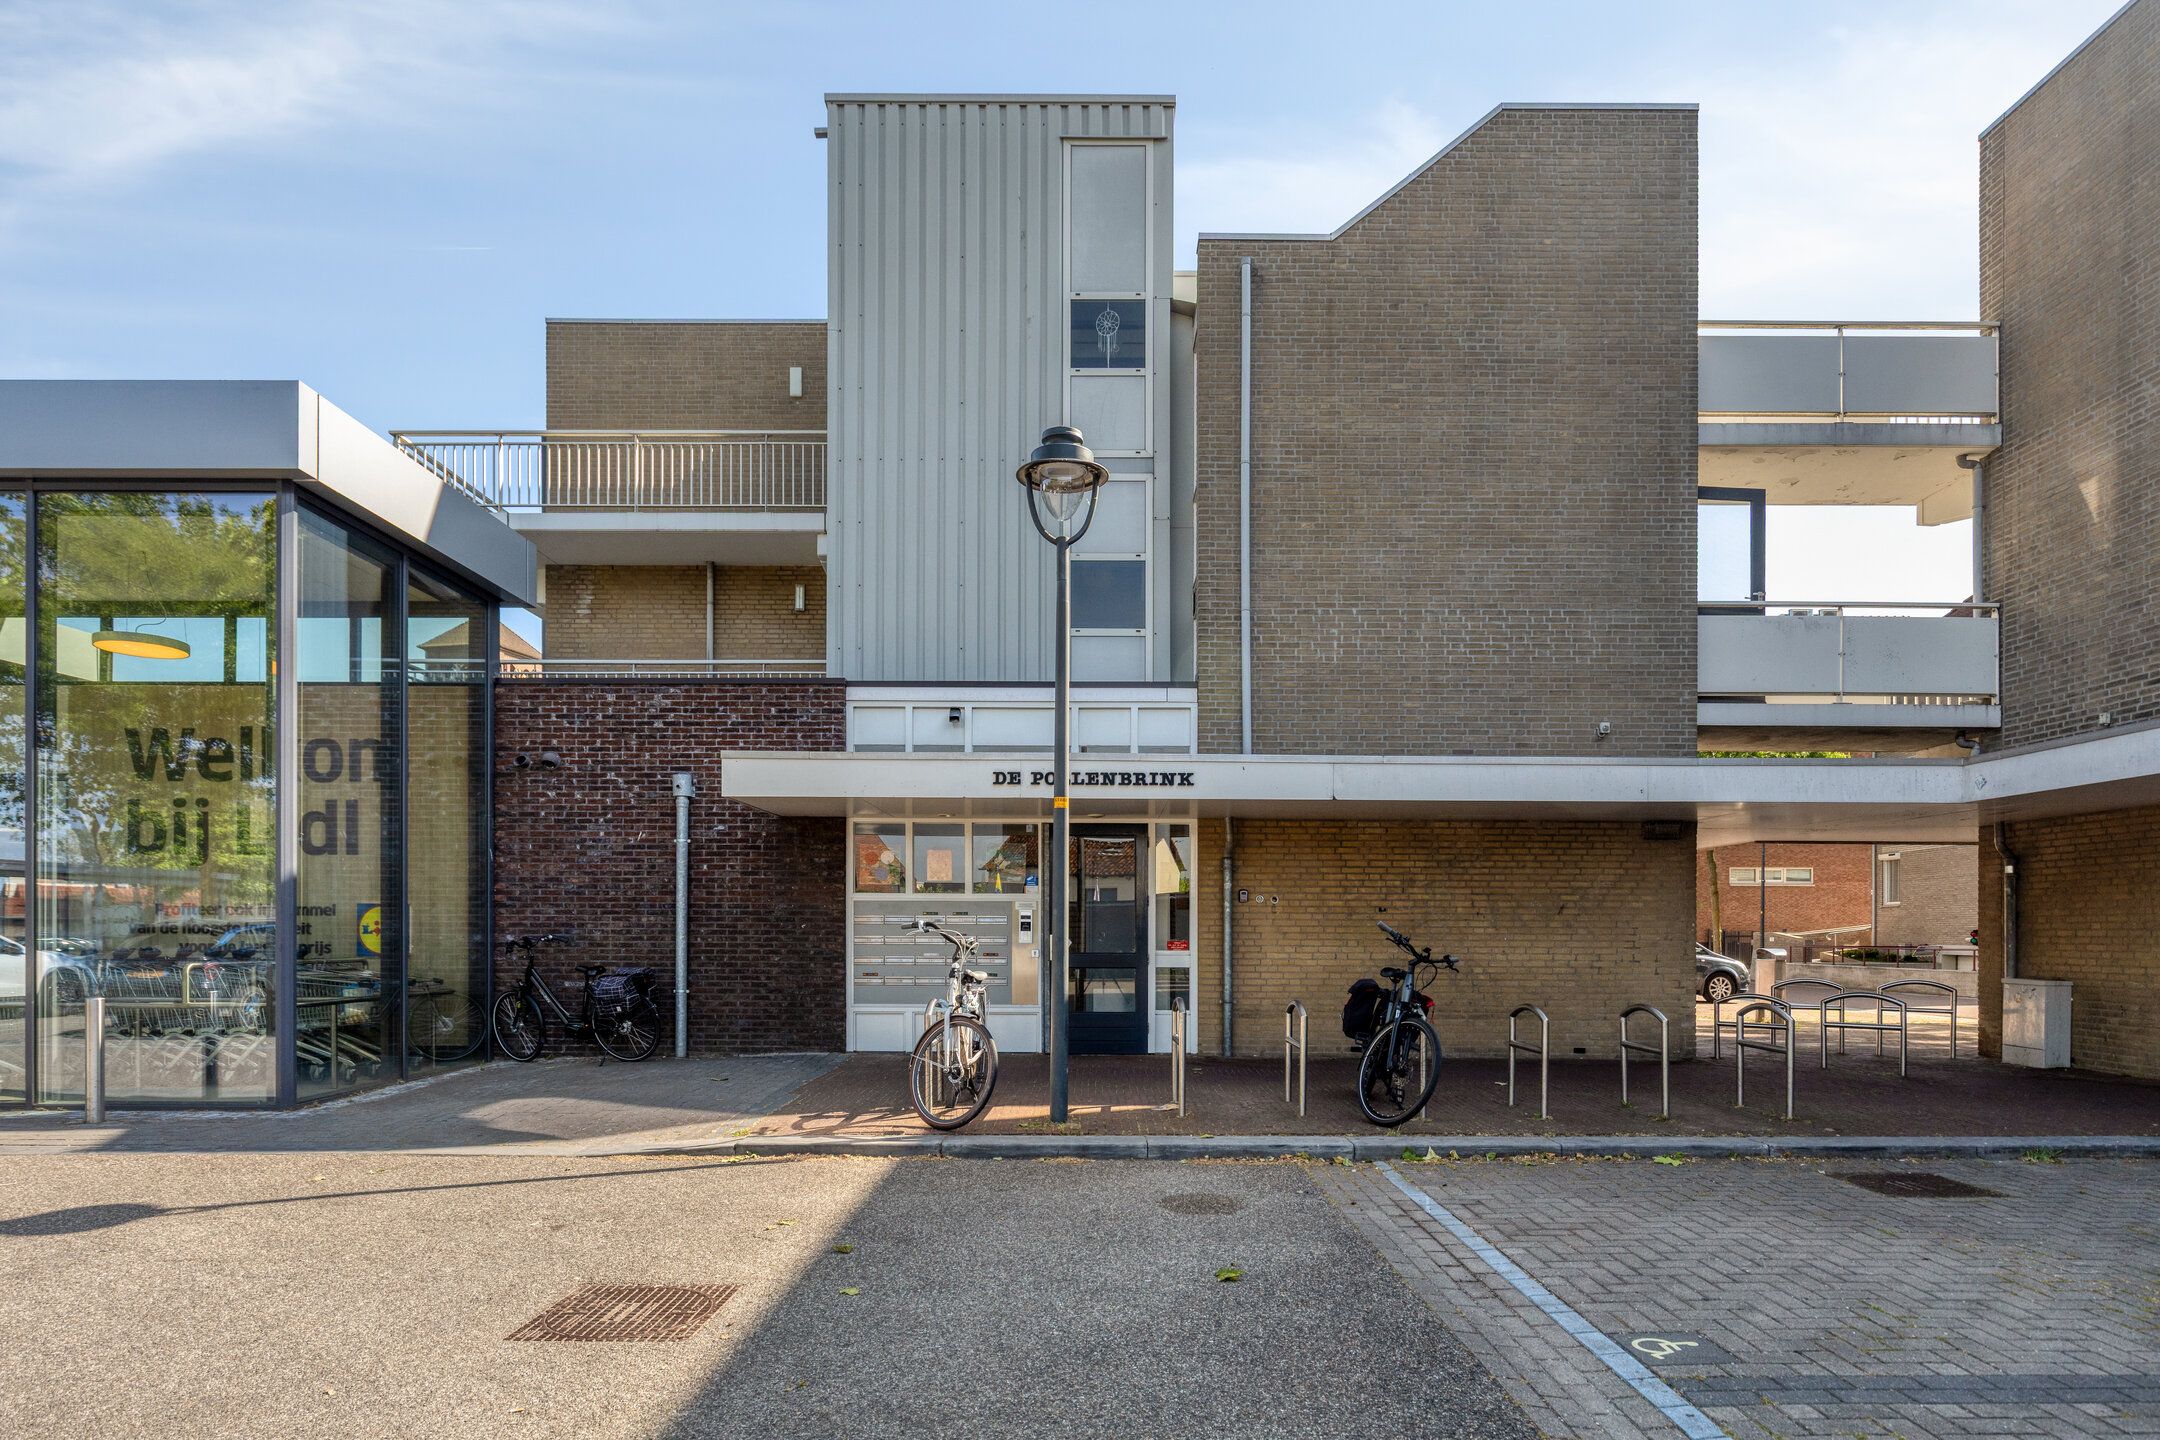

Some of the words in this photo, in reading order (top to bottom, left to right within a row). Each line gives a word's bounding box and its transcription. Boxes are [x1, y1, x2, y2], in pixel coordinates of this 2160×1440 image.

[125, 725, 386, 783] Welom
[993, 771, 1021, 785] DE
[1030, 771, 1195, 786] POLENBRINK
[126, 797, 209, 865] bij
[236, 799, 360, 856] Ldl
[155, 903, 222, 917] Profiteer
[225, 903, 254, 917] ook
[129, 922, 156, 934] van
[159, 920, 179, 934] de
